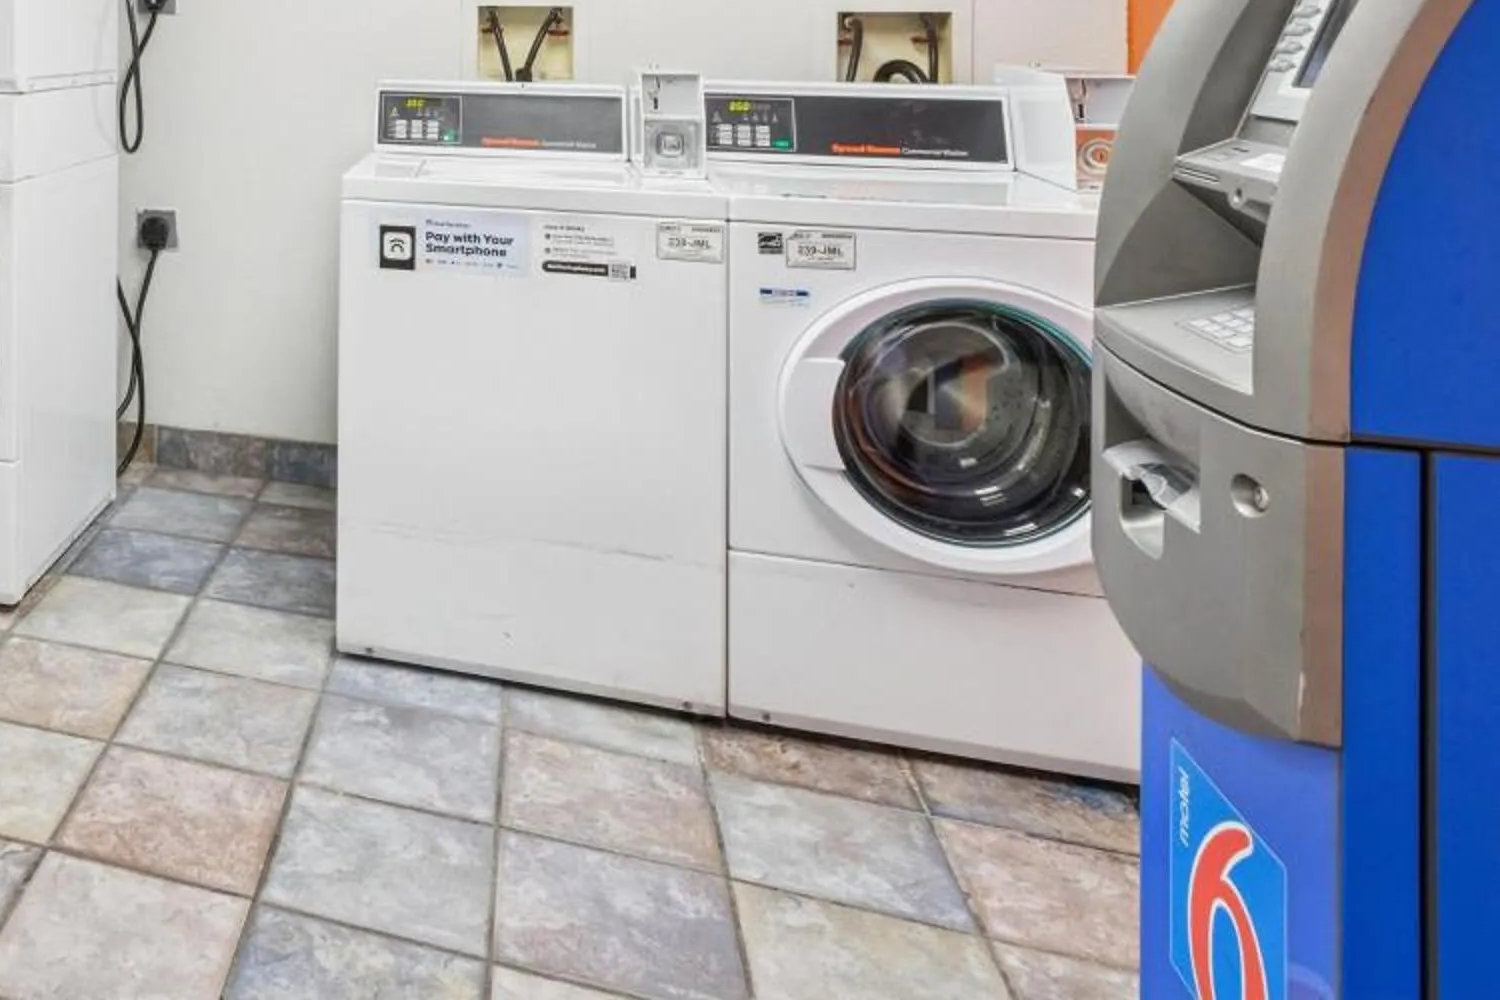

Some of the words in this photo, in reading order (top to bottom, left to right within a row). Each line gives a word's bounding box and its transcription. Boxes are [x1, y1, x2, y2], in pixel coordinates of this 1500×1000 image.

[425, 231, 451, 244] Pay
[453, 232, 481, 243] with
[483, 233, 514, 246] Your
[425, 243, 507, 257] Smartphone
